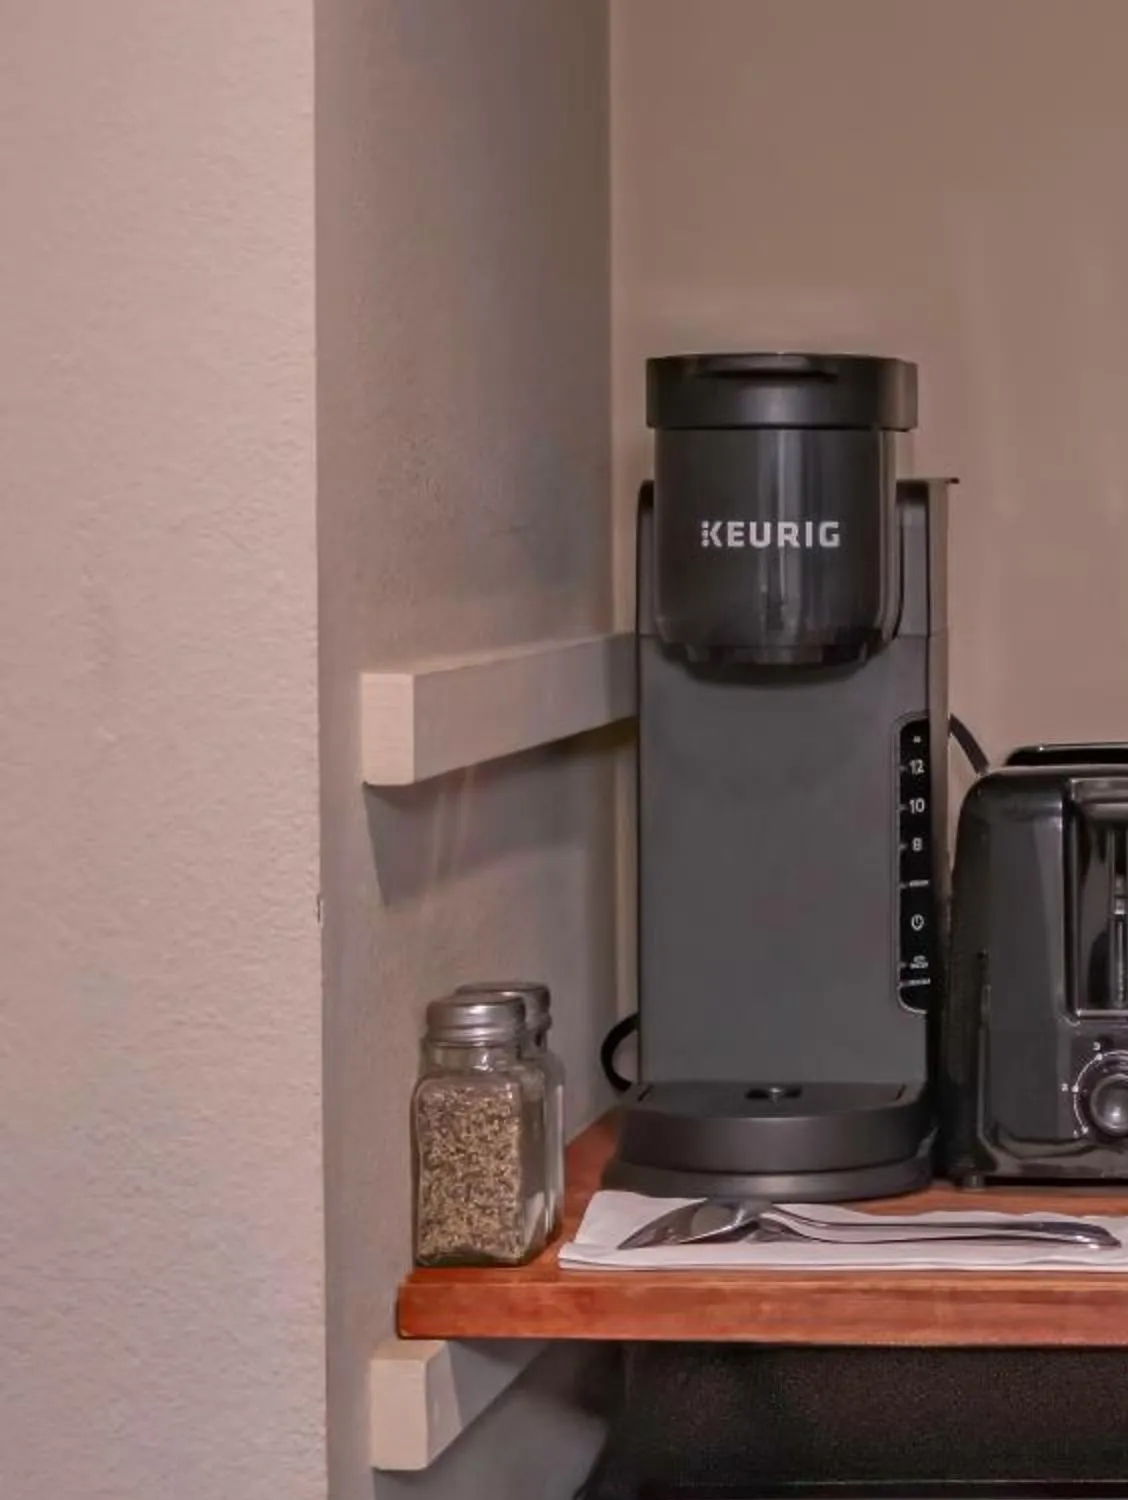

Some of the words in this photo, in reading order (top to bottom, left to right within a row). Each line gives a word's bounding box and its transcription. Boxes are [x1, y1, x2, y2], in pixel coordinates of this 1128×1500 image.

[701, 520, 840, 548] KEURIG
[909, 758, 925, 775] 12
[909, 798, 925, 813] 10
